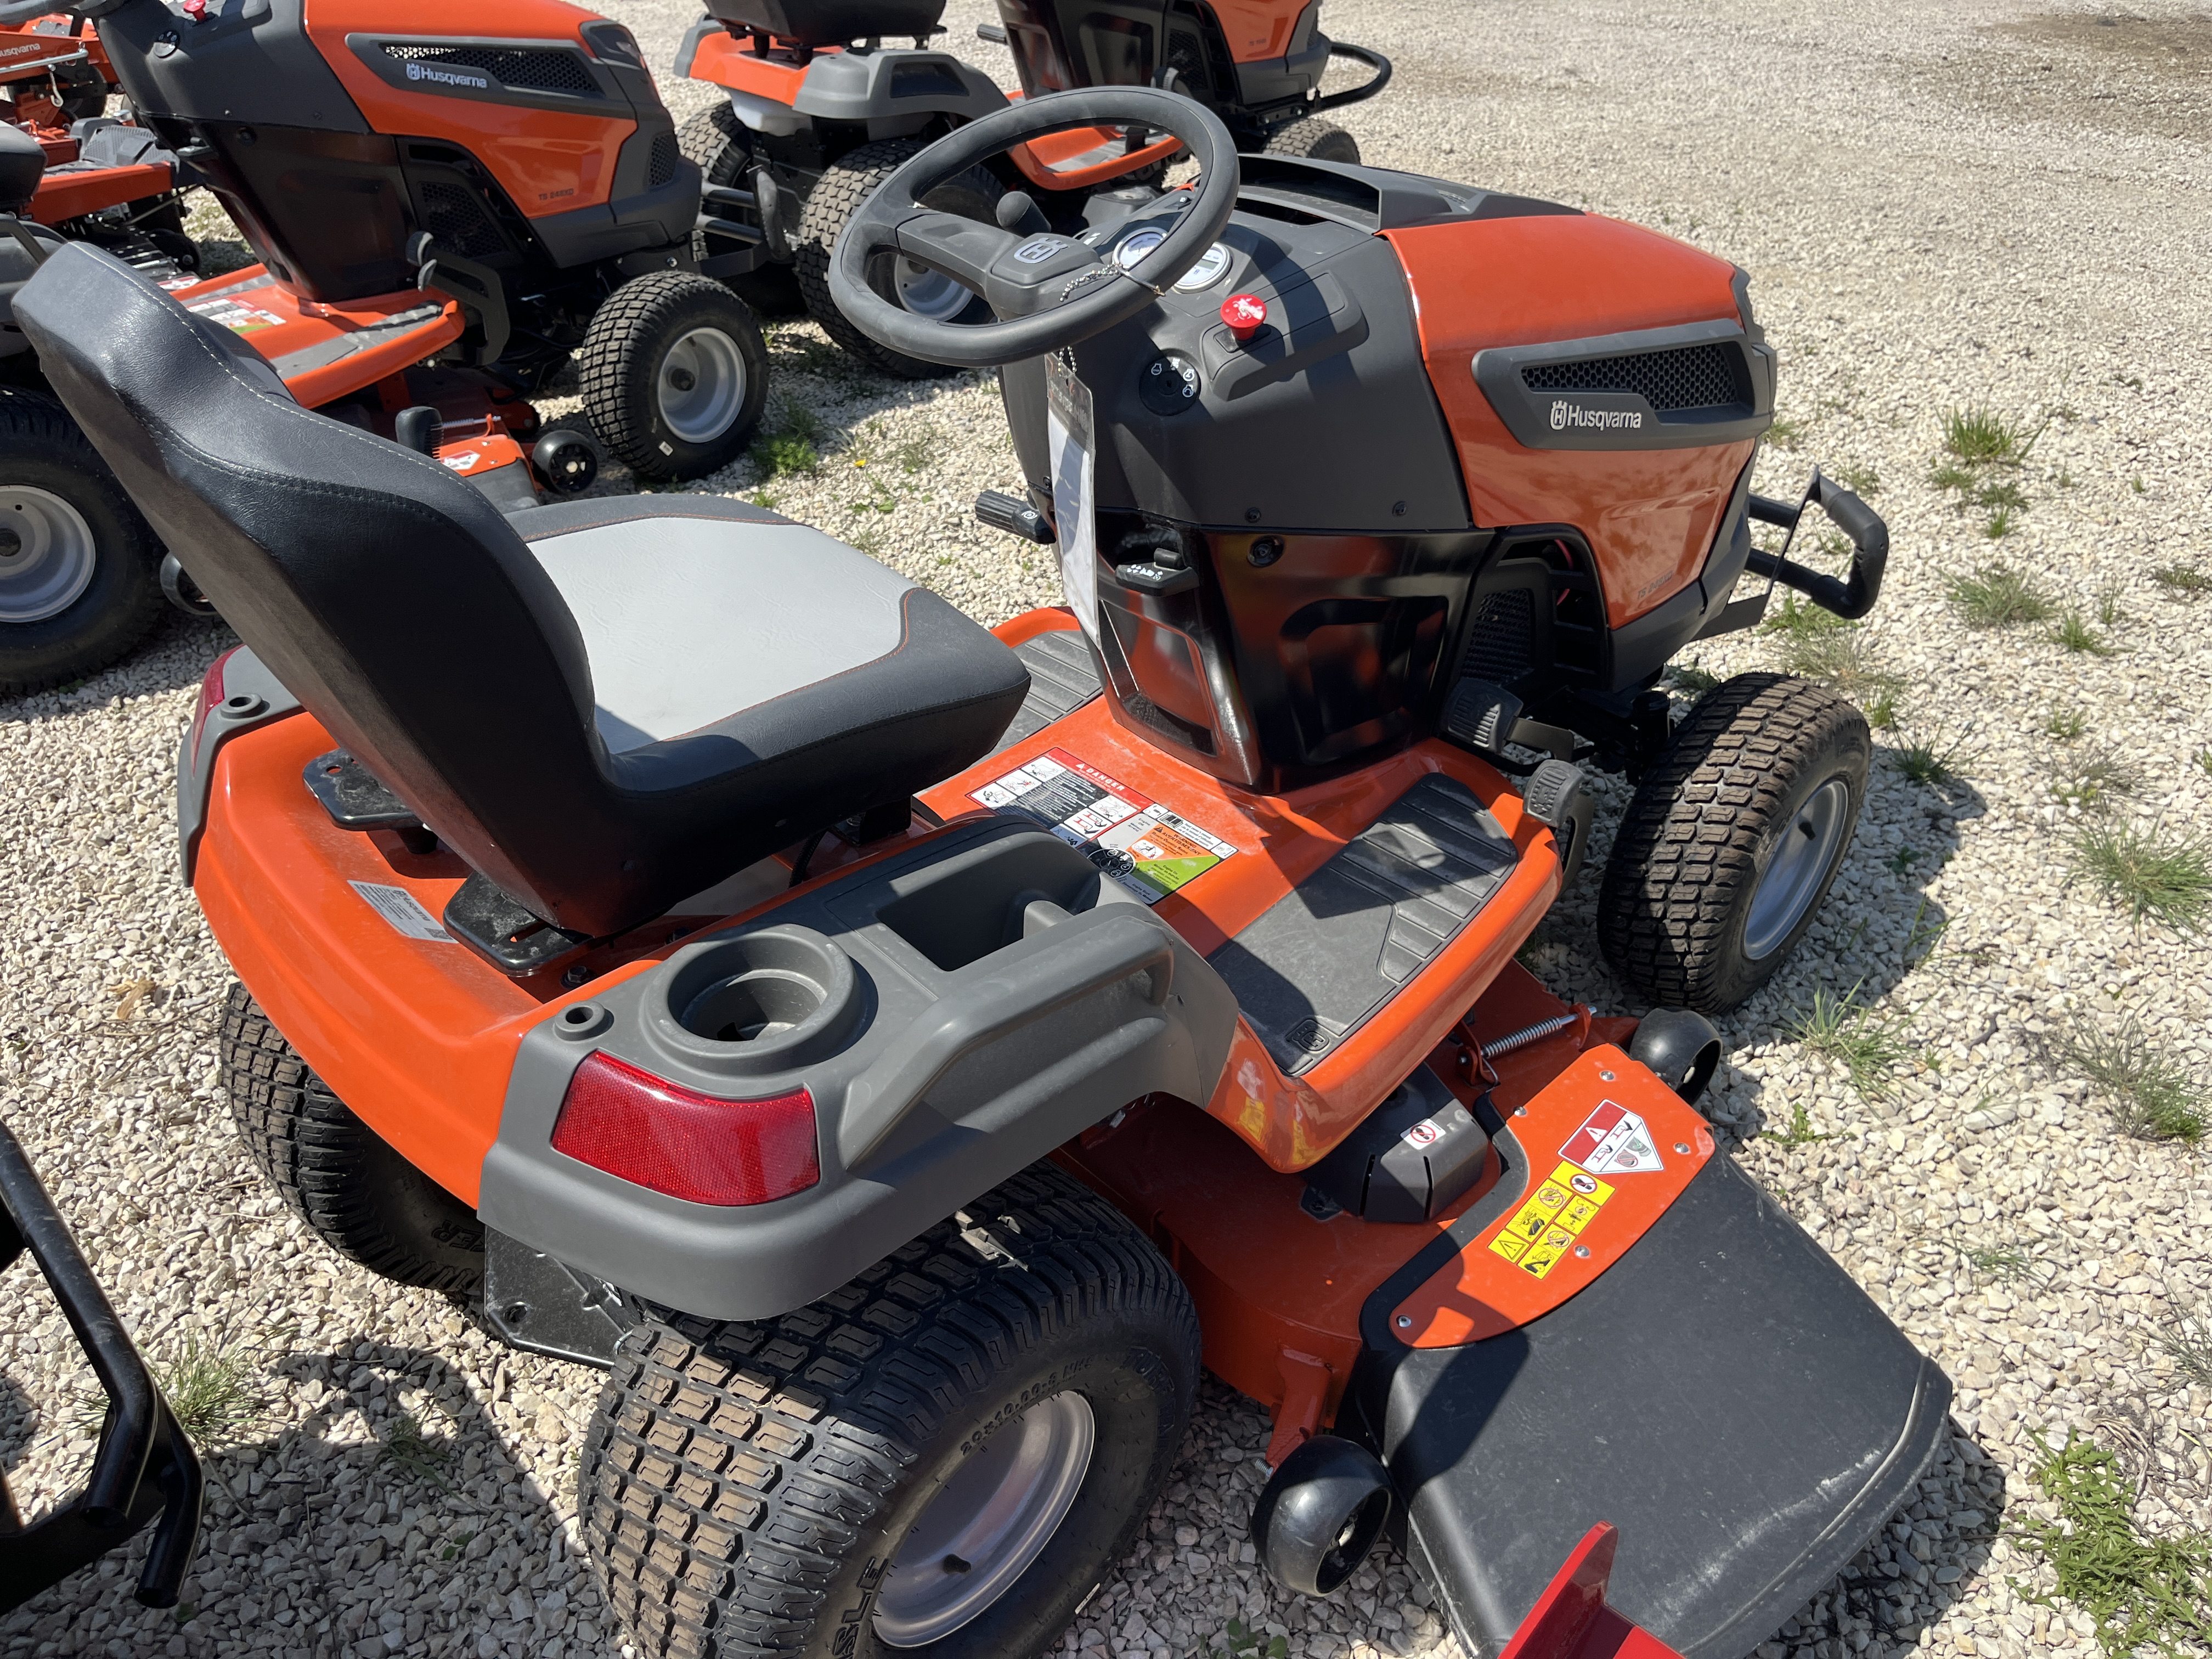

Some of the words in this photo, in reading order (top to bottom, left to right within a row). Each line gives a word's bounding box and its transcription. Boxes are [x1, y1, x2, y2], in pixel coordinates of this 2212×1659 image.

[421, 66, 488, 89] Husqvarna
[1567, 405, 1641, 431] Husqvarna
[1086, 768, 1125, 791] DANGER
[1172, 833, 1197, 848] WARNING
